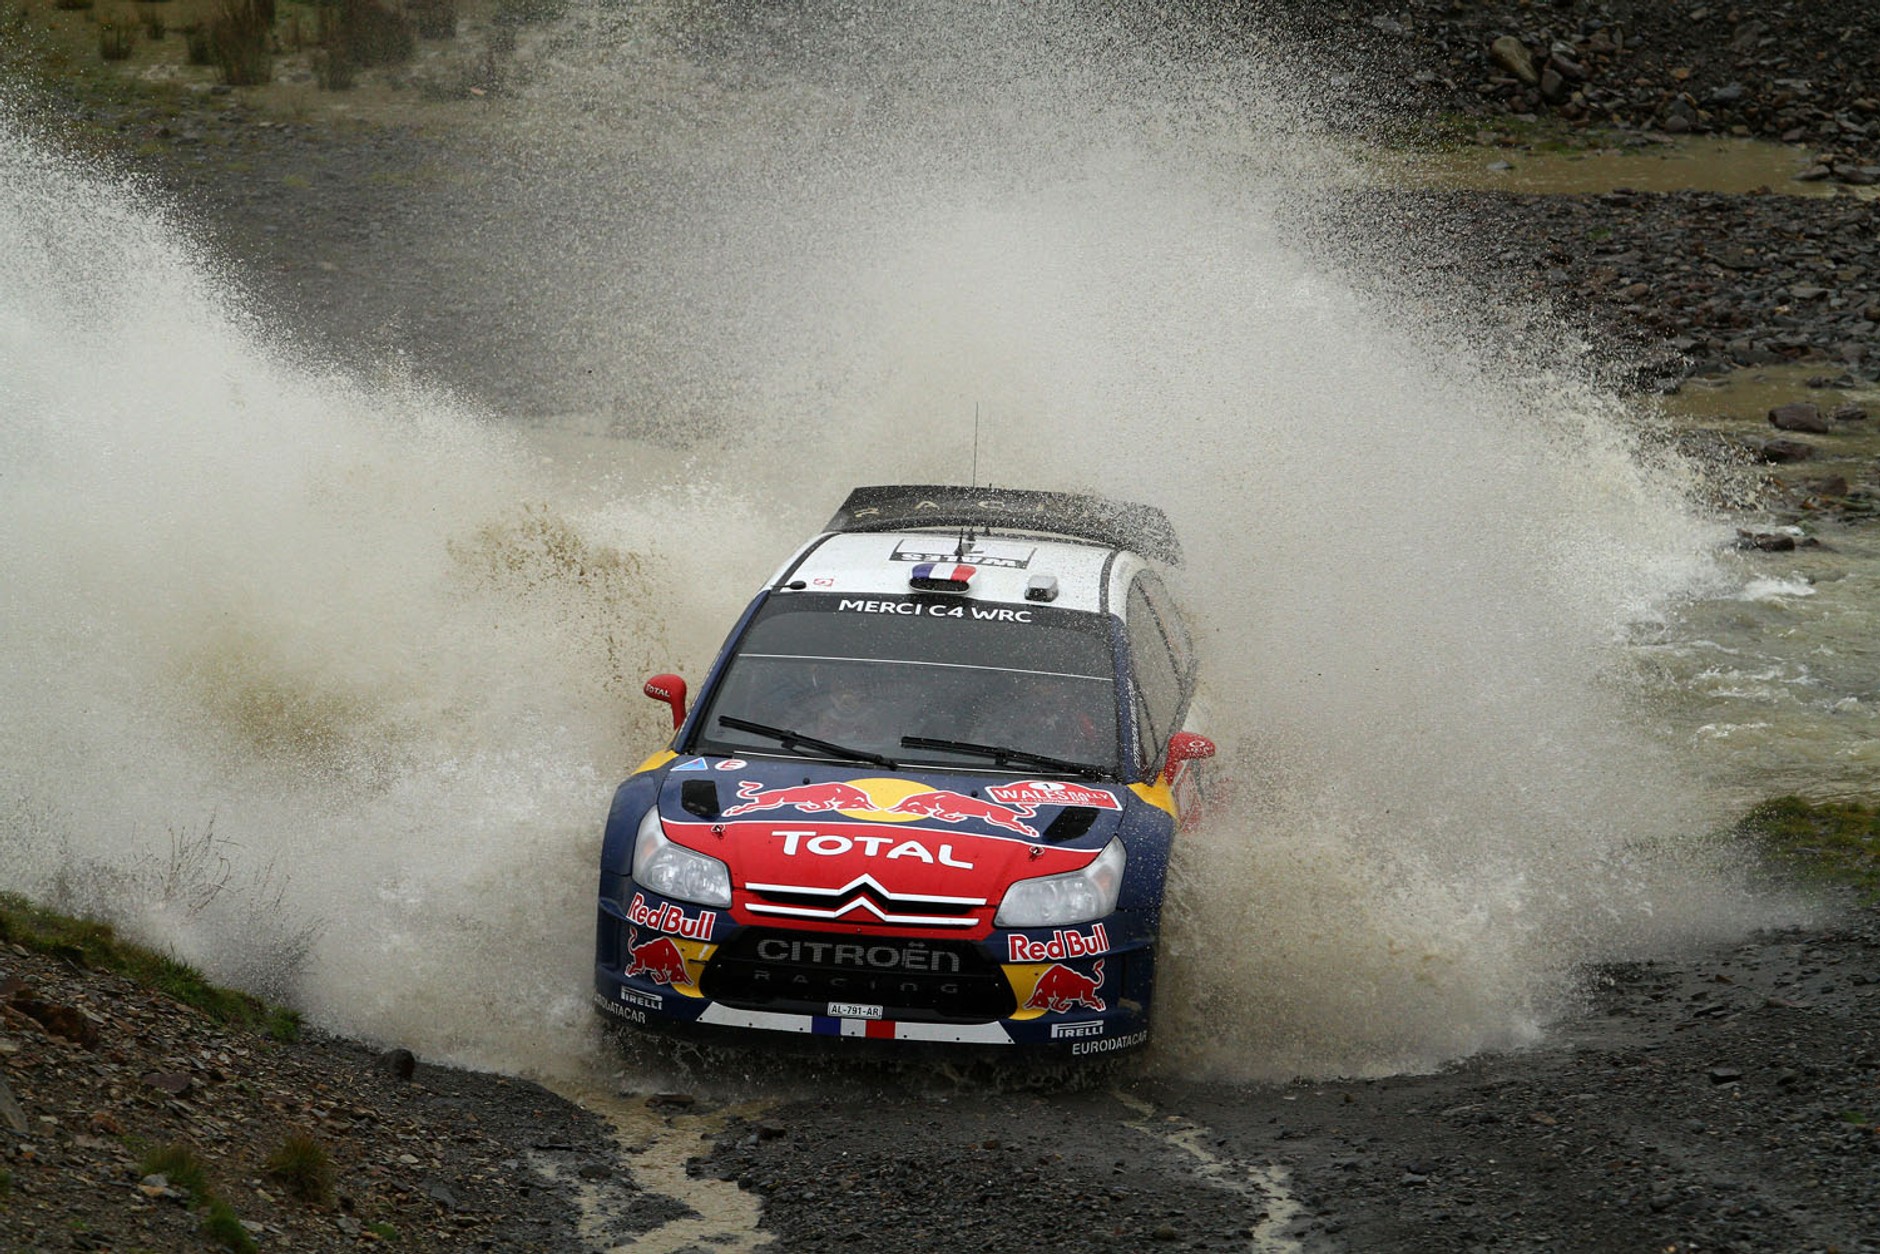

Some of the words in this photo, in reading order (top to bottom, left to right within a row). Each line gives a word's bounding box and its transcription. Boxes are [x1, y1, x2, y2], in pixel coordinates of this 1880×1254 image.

[838, 600, 921, 616] MERCI
[928, 605, 964, 618] C4
[971, 607, 1033, 623] WRC
[994, 789, 1069, 800] WALES
[771, 831, 974, 870] TOTAL
[626, 892, 667, 930] Red
[661, 905, 716, 941] Bull
[1008, 930, 1066, 962] Red
[1063, 923, 1110, 958] Bull
[754, 970, 959, 993] RACING
[620, 985, 663, 1011] PIRELLI
[831, 1004, 880, 1017] AL-791-AR
[1051, 1020, 1104, 1038] PIRELLI
[1072, 1031, 1147, 1055] EURODATACAR
